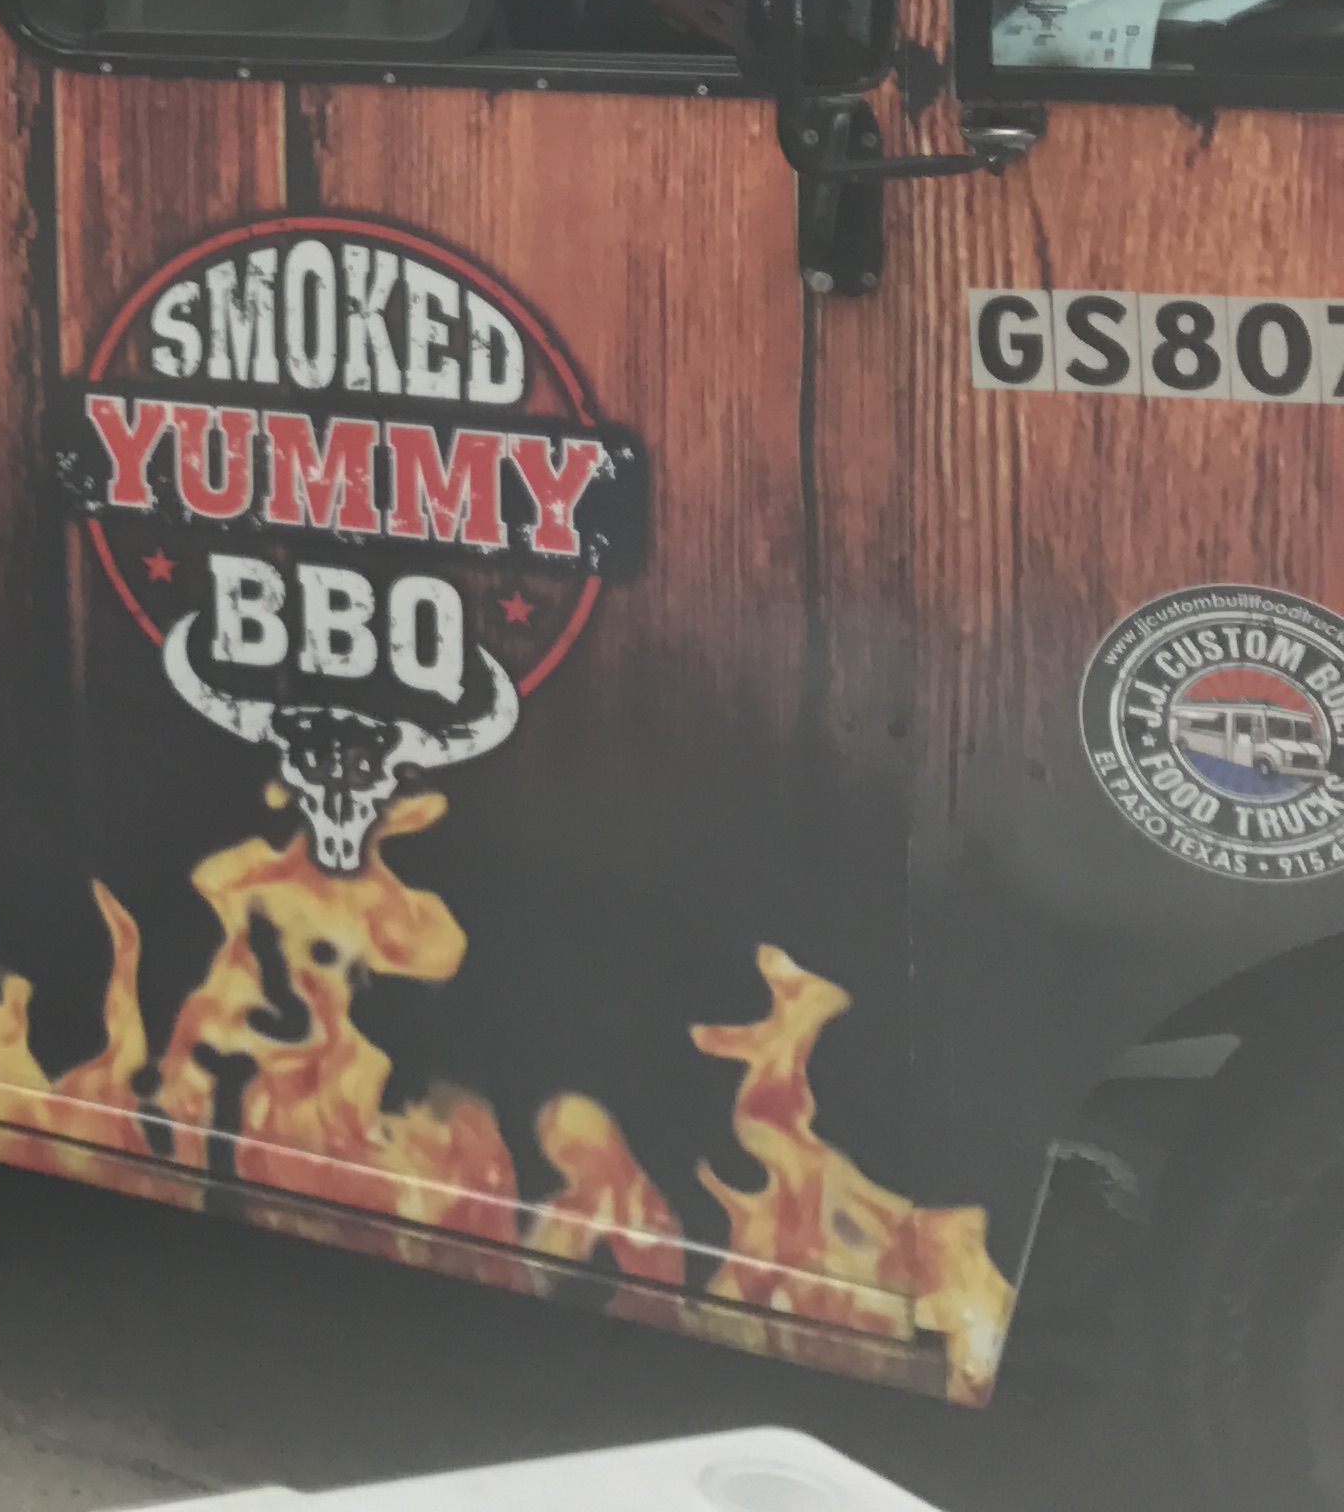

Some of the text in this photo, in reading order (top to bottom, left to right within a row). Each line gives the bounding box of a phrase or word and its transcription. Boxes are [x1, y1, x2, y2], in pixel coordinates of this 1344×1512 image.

[149, 239, 526, 405] SMOKED
[977, 294, 1344, 398] GS80
[85, 393, 604, 557] YUMMY
[206, 552, 467, 705] BBQ
[1154, 626, 1307, 680] CUSTOM
[1094, 751, 1119, 777] EL
[1109, 778, 1168, 835] PASO
[1170, 829, 1248, 874] TEXAS
[1139, 751, 1221, 824] FOOD
